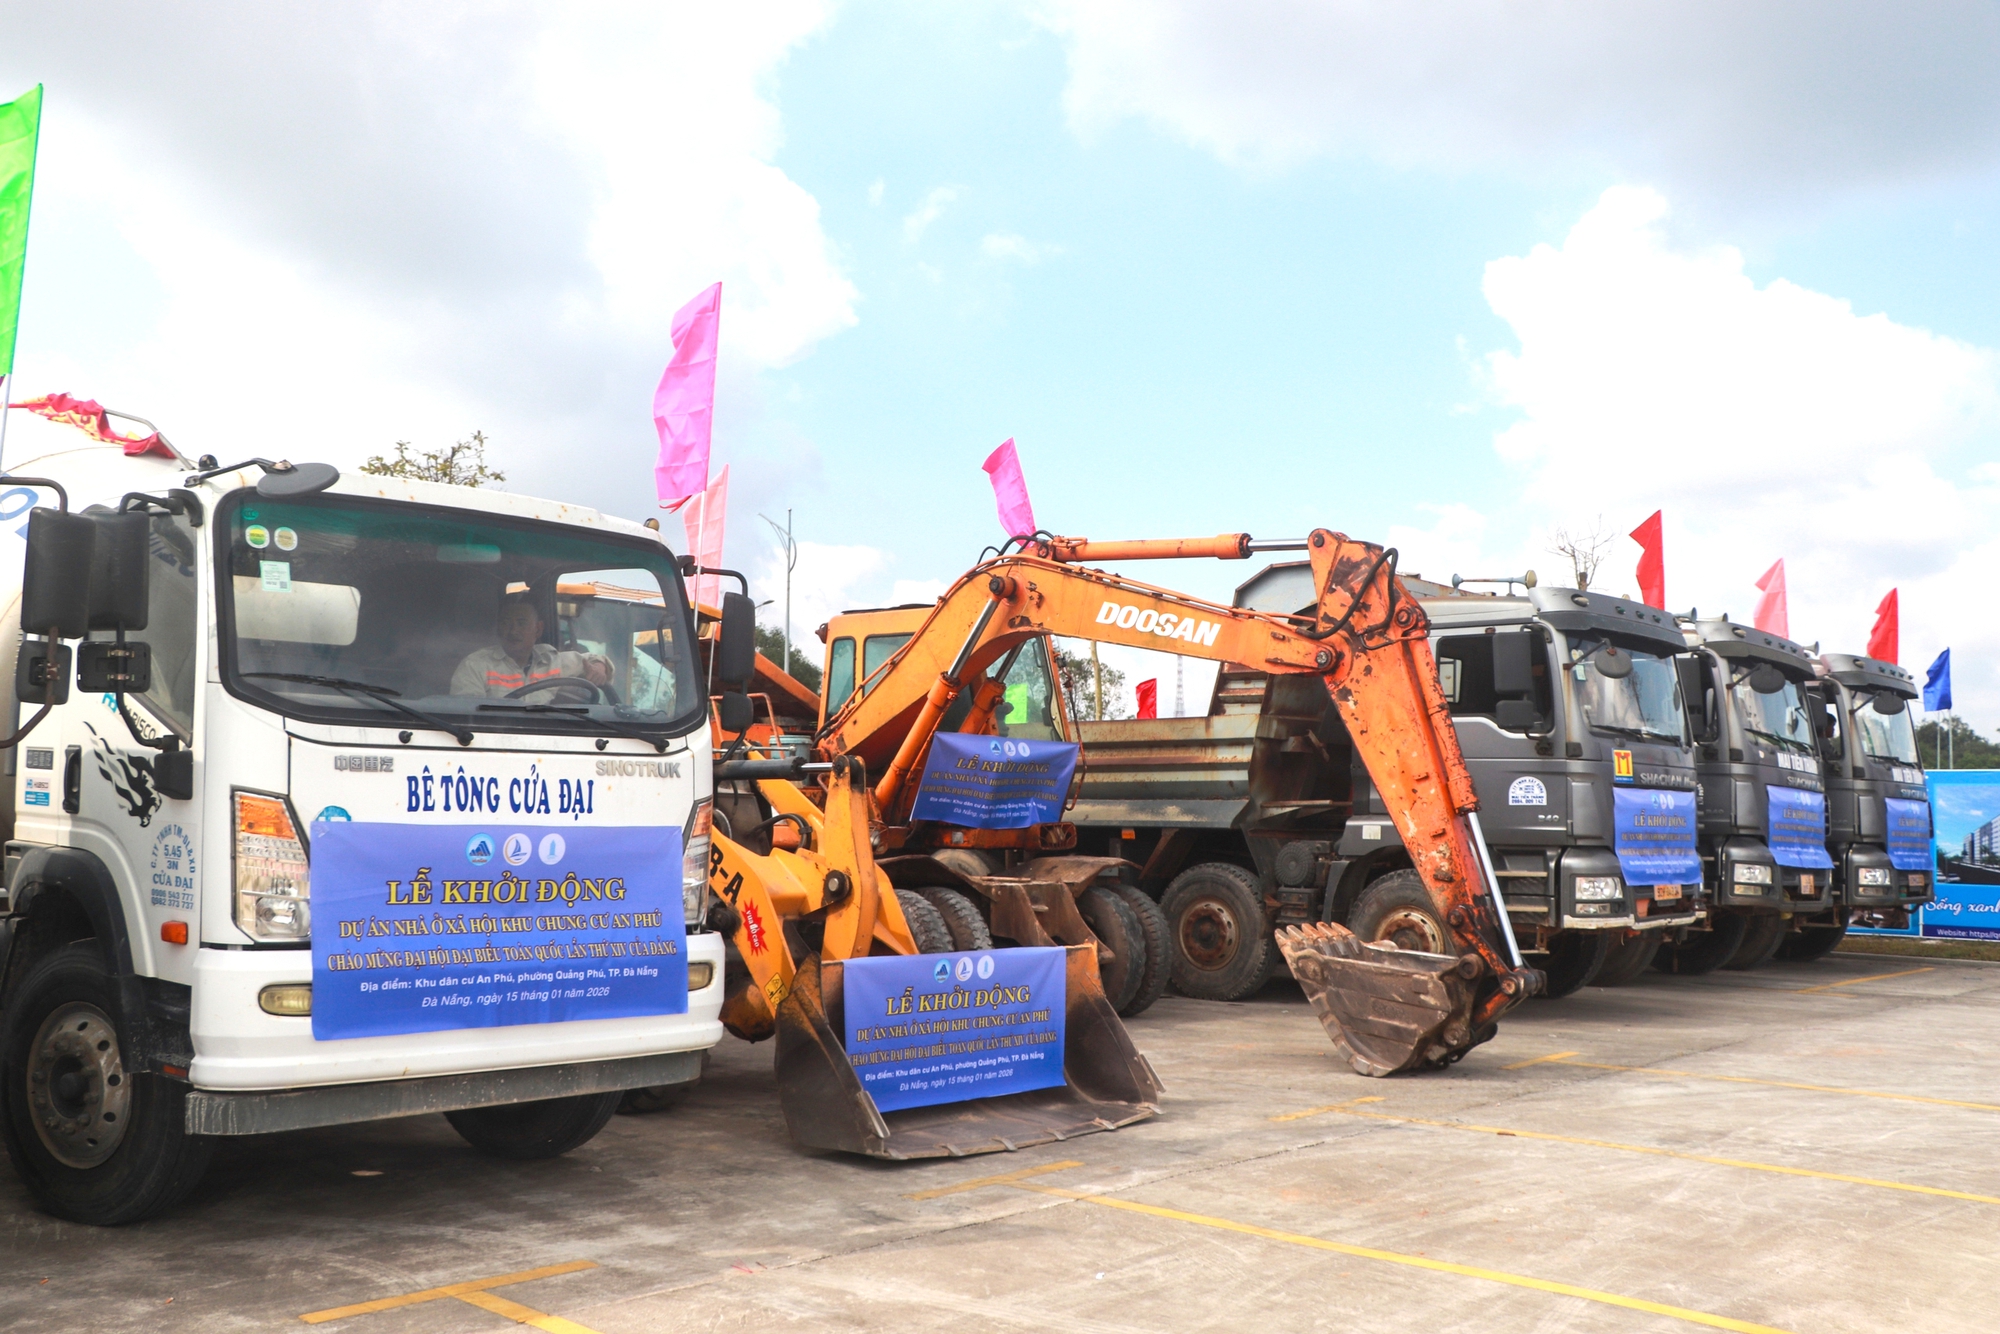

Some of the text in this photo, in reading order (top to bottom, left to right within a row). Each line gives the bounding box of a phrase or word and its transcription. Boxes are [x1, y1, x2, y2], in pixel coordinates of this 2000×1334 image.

[1095, 601, 1221, 647] DOOSAN
[334, 755, 394, 772] 中国重汽
[595, 759, 681, 778] SINOTRUK
[955, 755, 980, 770] LỄ
[406, 764, 594, 821] BÊ TÔNG CỬA ĐẠI
[152, 870, 193, 891] CỬA ĐẠI
[386, 867, 626, 908] LỄ KHỞI ĐỘNG
[181, 893, 194, 902] 777
[339, 908, 662, 942] DỰ ÁN NHÀ Ở XÃ HỘI KHU CHUNG CƯ AN PHÚ
[328, 935, 677, 971] CHÀO MỪNG ĐẠI HỘI ĐẠI BIỂU TOÀN QUỐC LẦN THỨ XIV CỦA ĐẢNG
[360, 966, 658, 993] Địa điểm: Khu dân cư An Phú, phường Quảng Phú, TP. Đà Nẵng
[422, 987, 610, 1007] Đà Nẵng, ngày 15 tháng 01 năm 2026
[886, 983, 1031, 1016] LỄ KHỞI ĐỘNG
